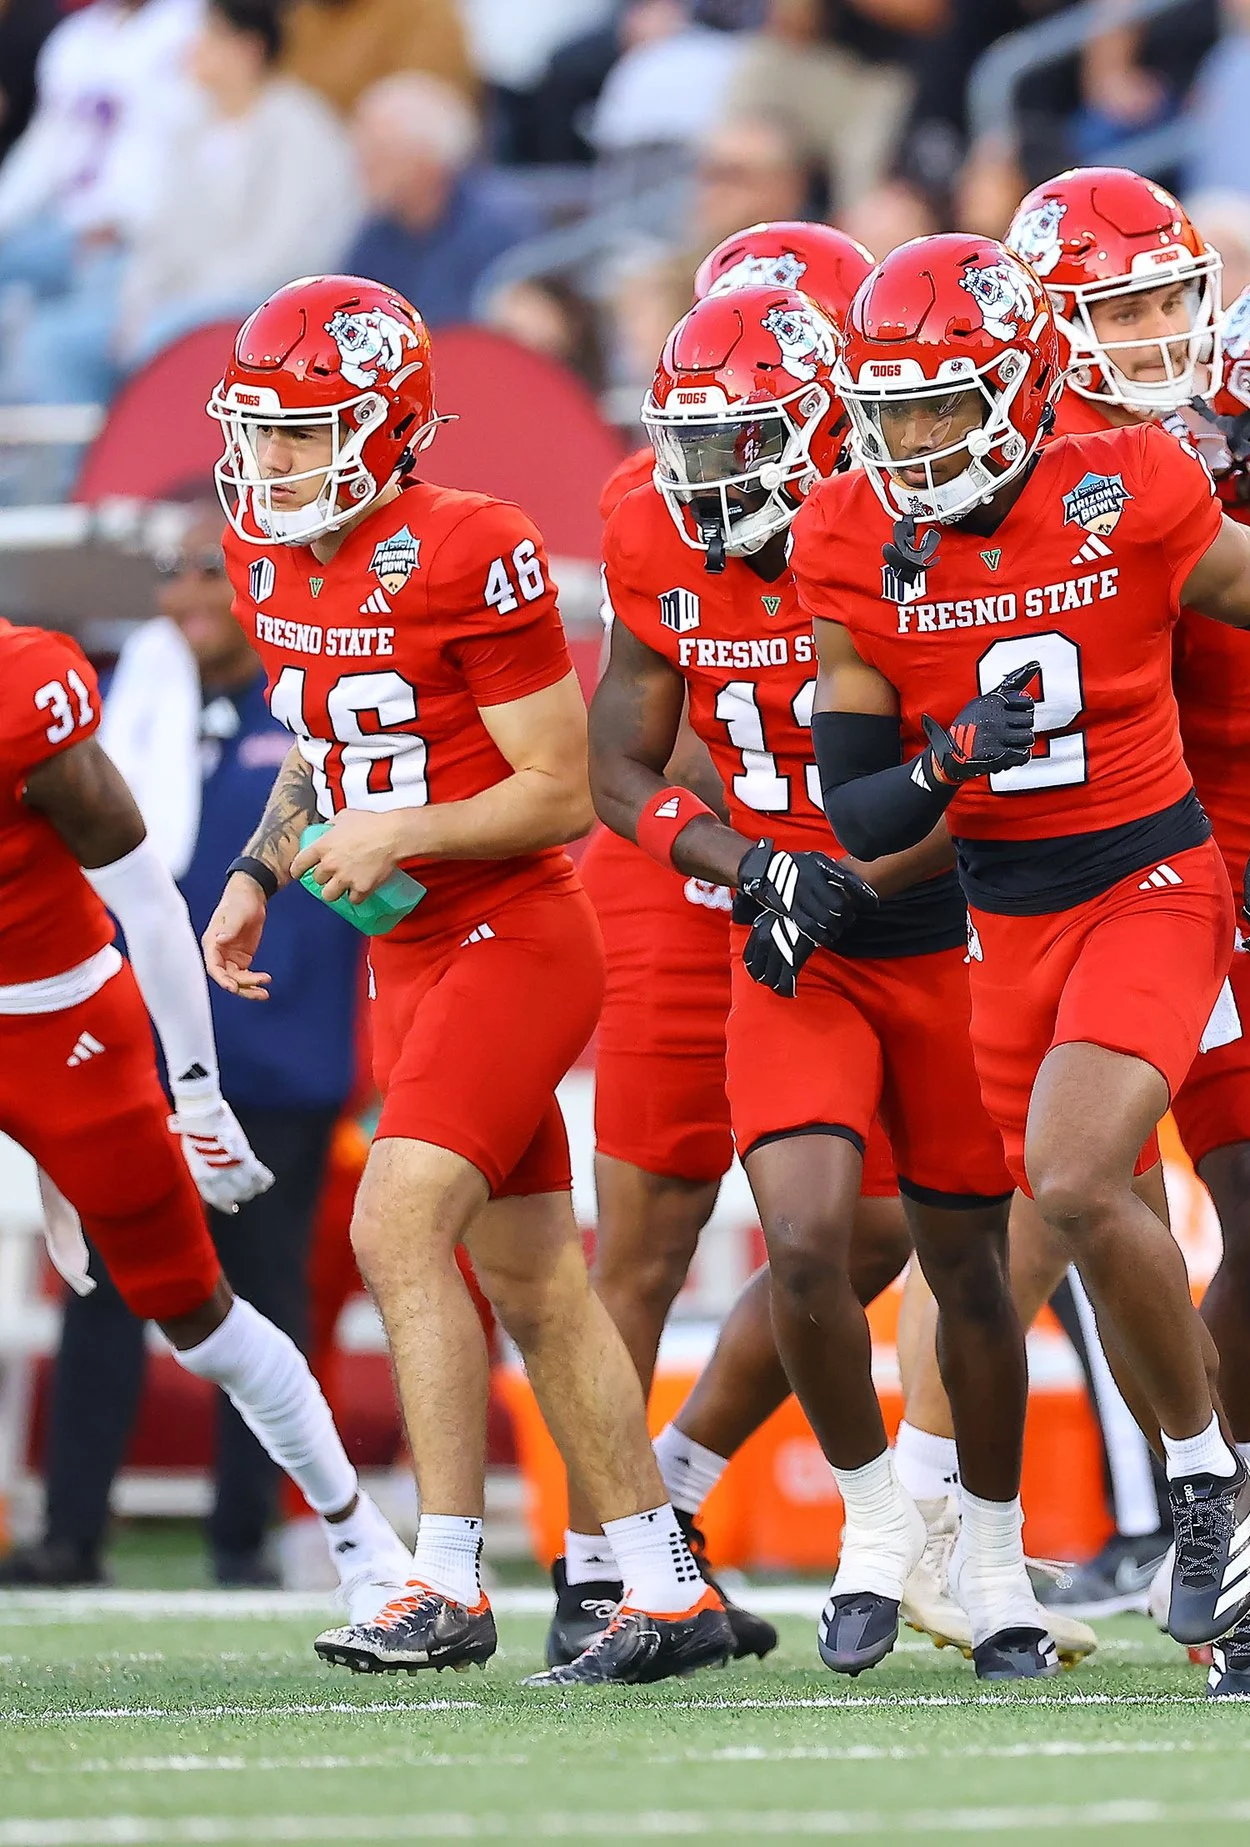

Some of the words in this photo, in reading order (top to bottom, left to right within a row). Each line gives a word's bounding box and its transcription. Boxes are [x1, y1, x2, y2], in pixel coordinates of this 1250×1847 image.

[1068, 484, 1123, 518] ARIZONA
[1080, 498, 1118, 523] BOWL
[374, 548, 416, 566] ARIZONA
[381, 560, 408, 575] BOWL
[483, 538, 545, 615] 46
[896, 592, 1017, 635] FRESNO
[1025, 567, 1120, 617] STATE
[255, 611, 323, 655] FRESNO
[325, 626, 395, 657] STATE
[678, 637, 788, 669] FRESNO
[33, 667, 95, 745] 31
[976, 629, 1089, 793] 2
